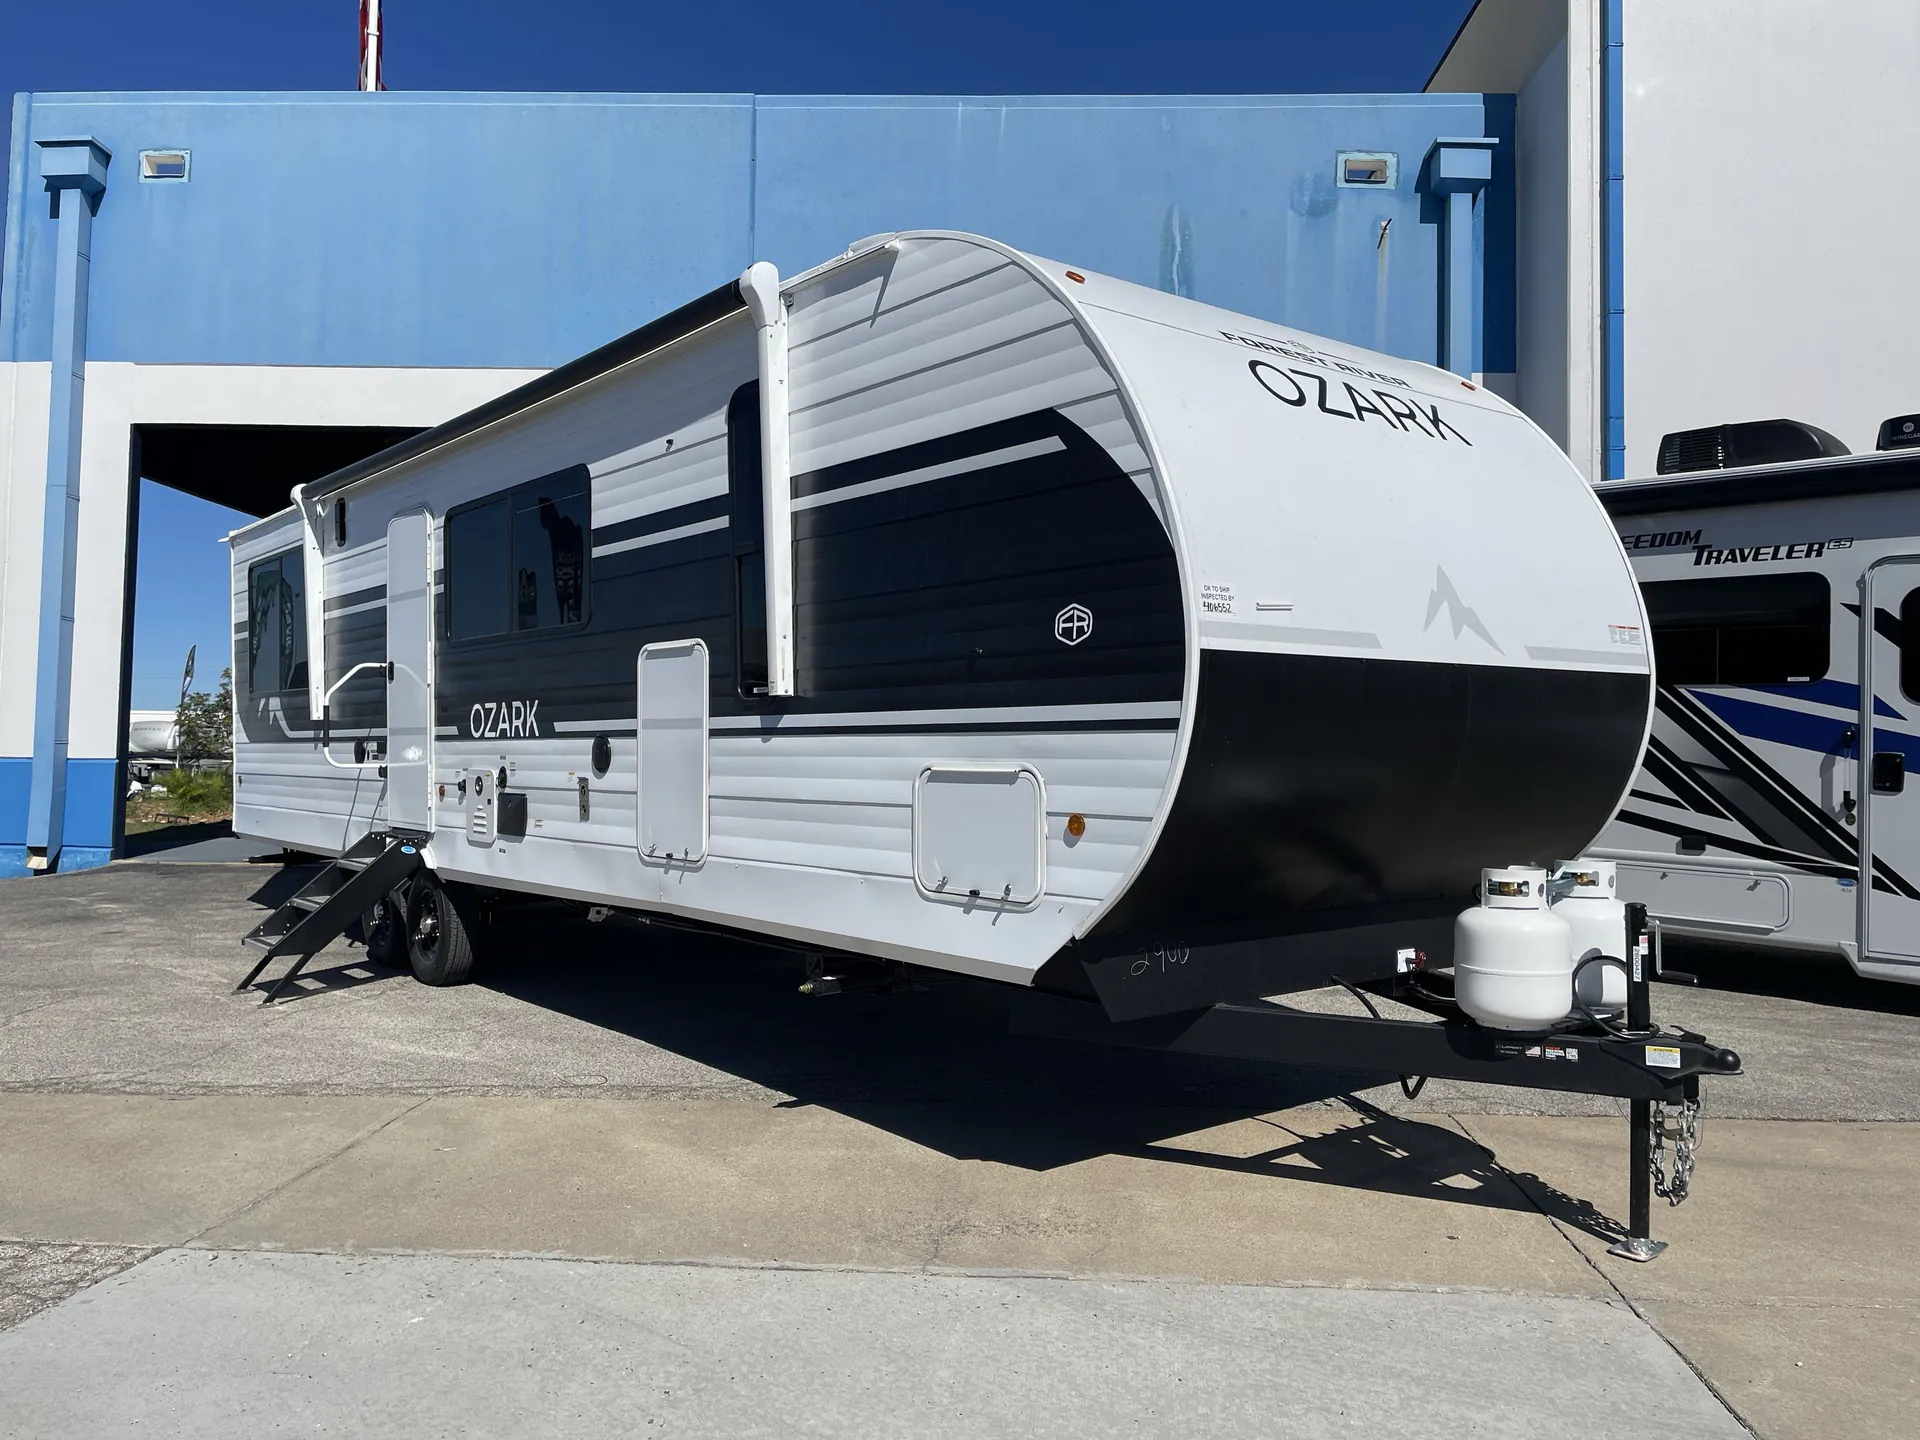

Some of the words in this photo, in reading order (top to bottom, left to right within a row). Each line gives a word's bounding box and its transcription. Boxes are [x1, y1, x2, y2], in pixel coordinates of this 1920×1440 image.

[1217, 330, 1328, 366] FOREST
[1332, 361, 1413, 388] RIVER
[1248, 359, 1473, 447] OZARK
[1692, 542, 1826, 566] TRAVELER
[1829, 538, 1852, 550] ES
[1201, 592, 1227, 601] INSPECTED
[1228, 594, 1235, 602] BY
[1203, 584, 1211, 592] OK
[470, 700, 540, 738] OZARK
